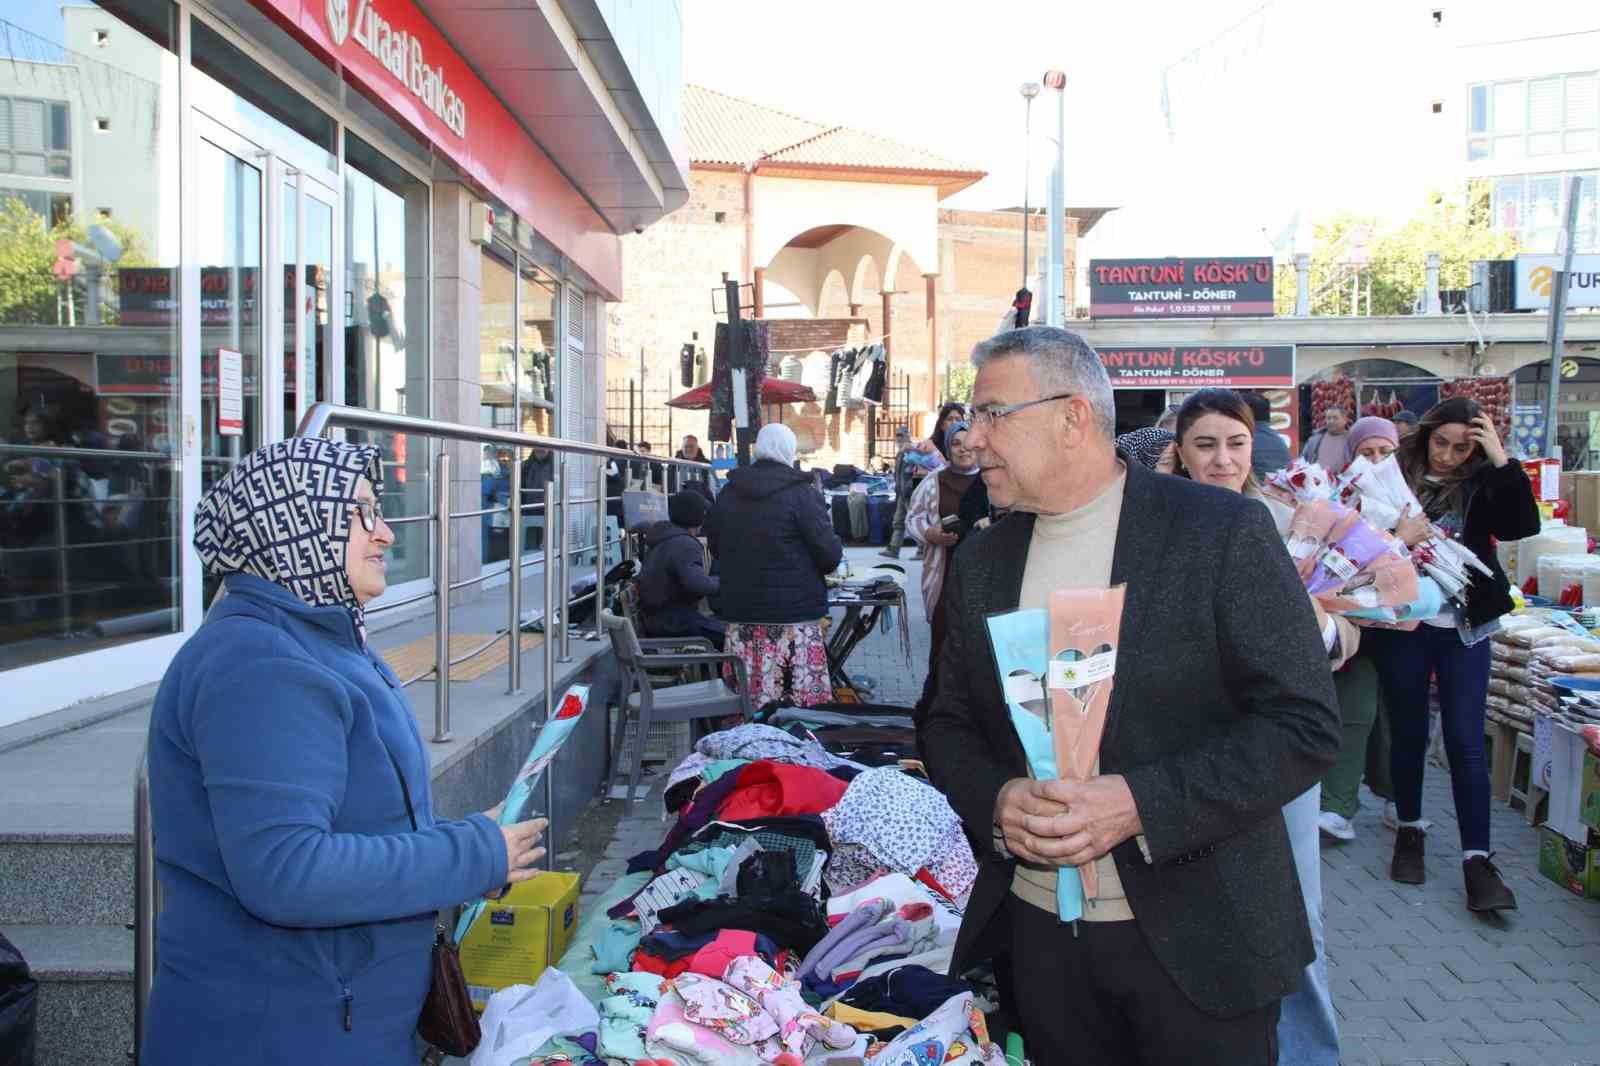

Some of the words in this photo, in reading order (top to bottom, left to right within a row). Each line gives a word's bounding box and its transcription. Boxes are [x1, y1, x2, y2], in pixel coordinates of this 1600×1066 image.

[351, 0, 409, 89] Ziraat
[411, 36, 465, 139] Bankası
[1096, 260, 1185, 285] TANTUNİ
[1128, 288, 1182, 301] TANTUNİ
[1193, 288, 1237, 300] DÖNER
[1099, 346, 1176, 367] ANTUNİ
[1119, 368, 1172, 376] TANTUNİ
[1182, 367, 1225, 376] DÖNER
